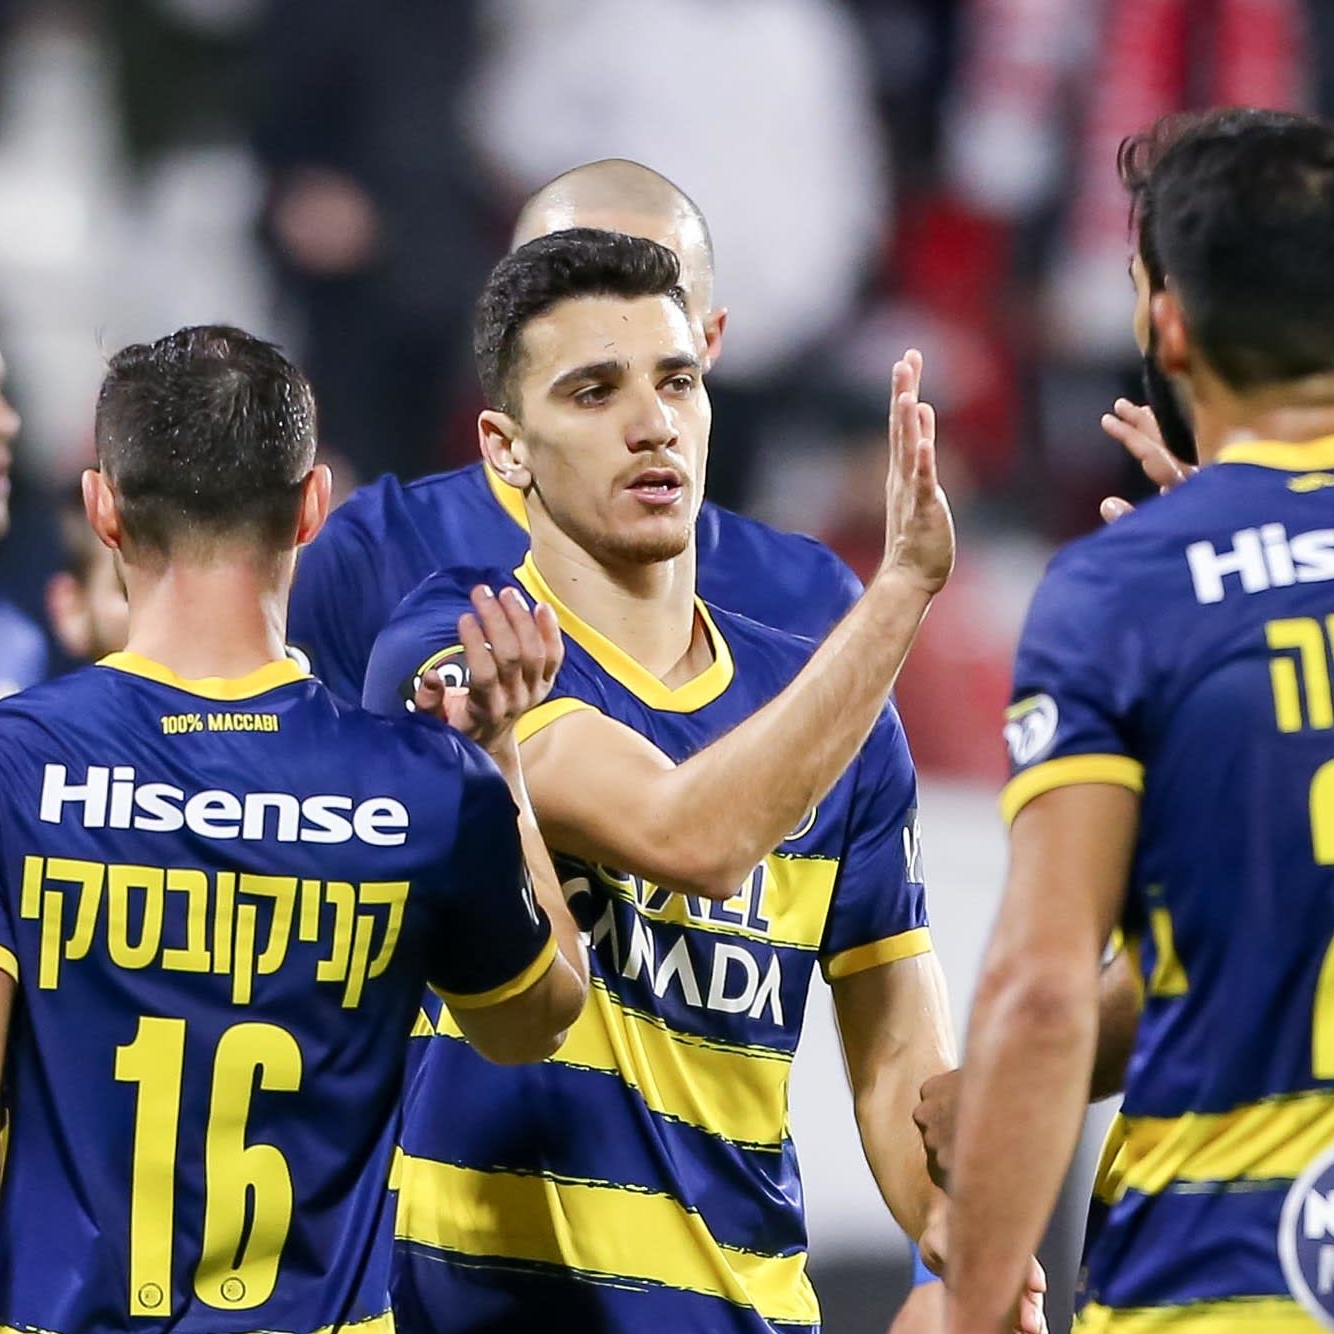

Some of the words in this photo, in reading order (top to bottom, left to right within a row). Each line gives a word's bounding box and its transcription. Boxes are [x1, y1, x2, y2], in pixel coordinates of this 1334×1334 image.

[160, 713, 204, 735] 100%
[207, 712, 279, 732] MACCABI
[40, 764, 409, 846] Hisense
[21, 856, 409, 1008] קניקובסקי
[114, 1015, 302, 1317] 16
